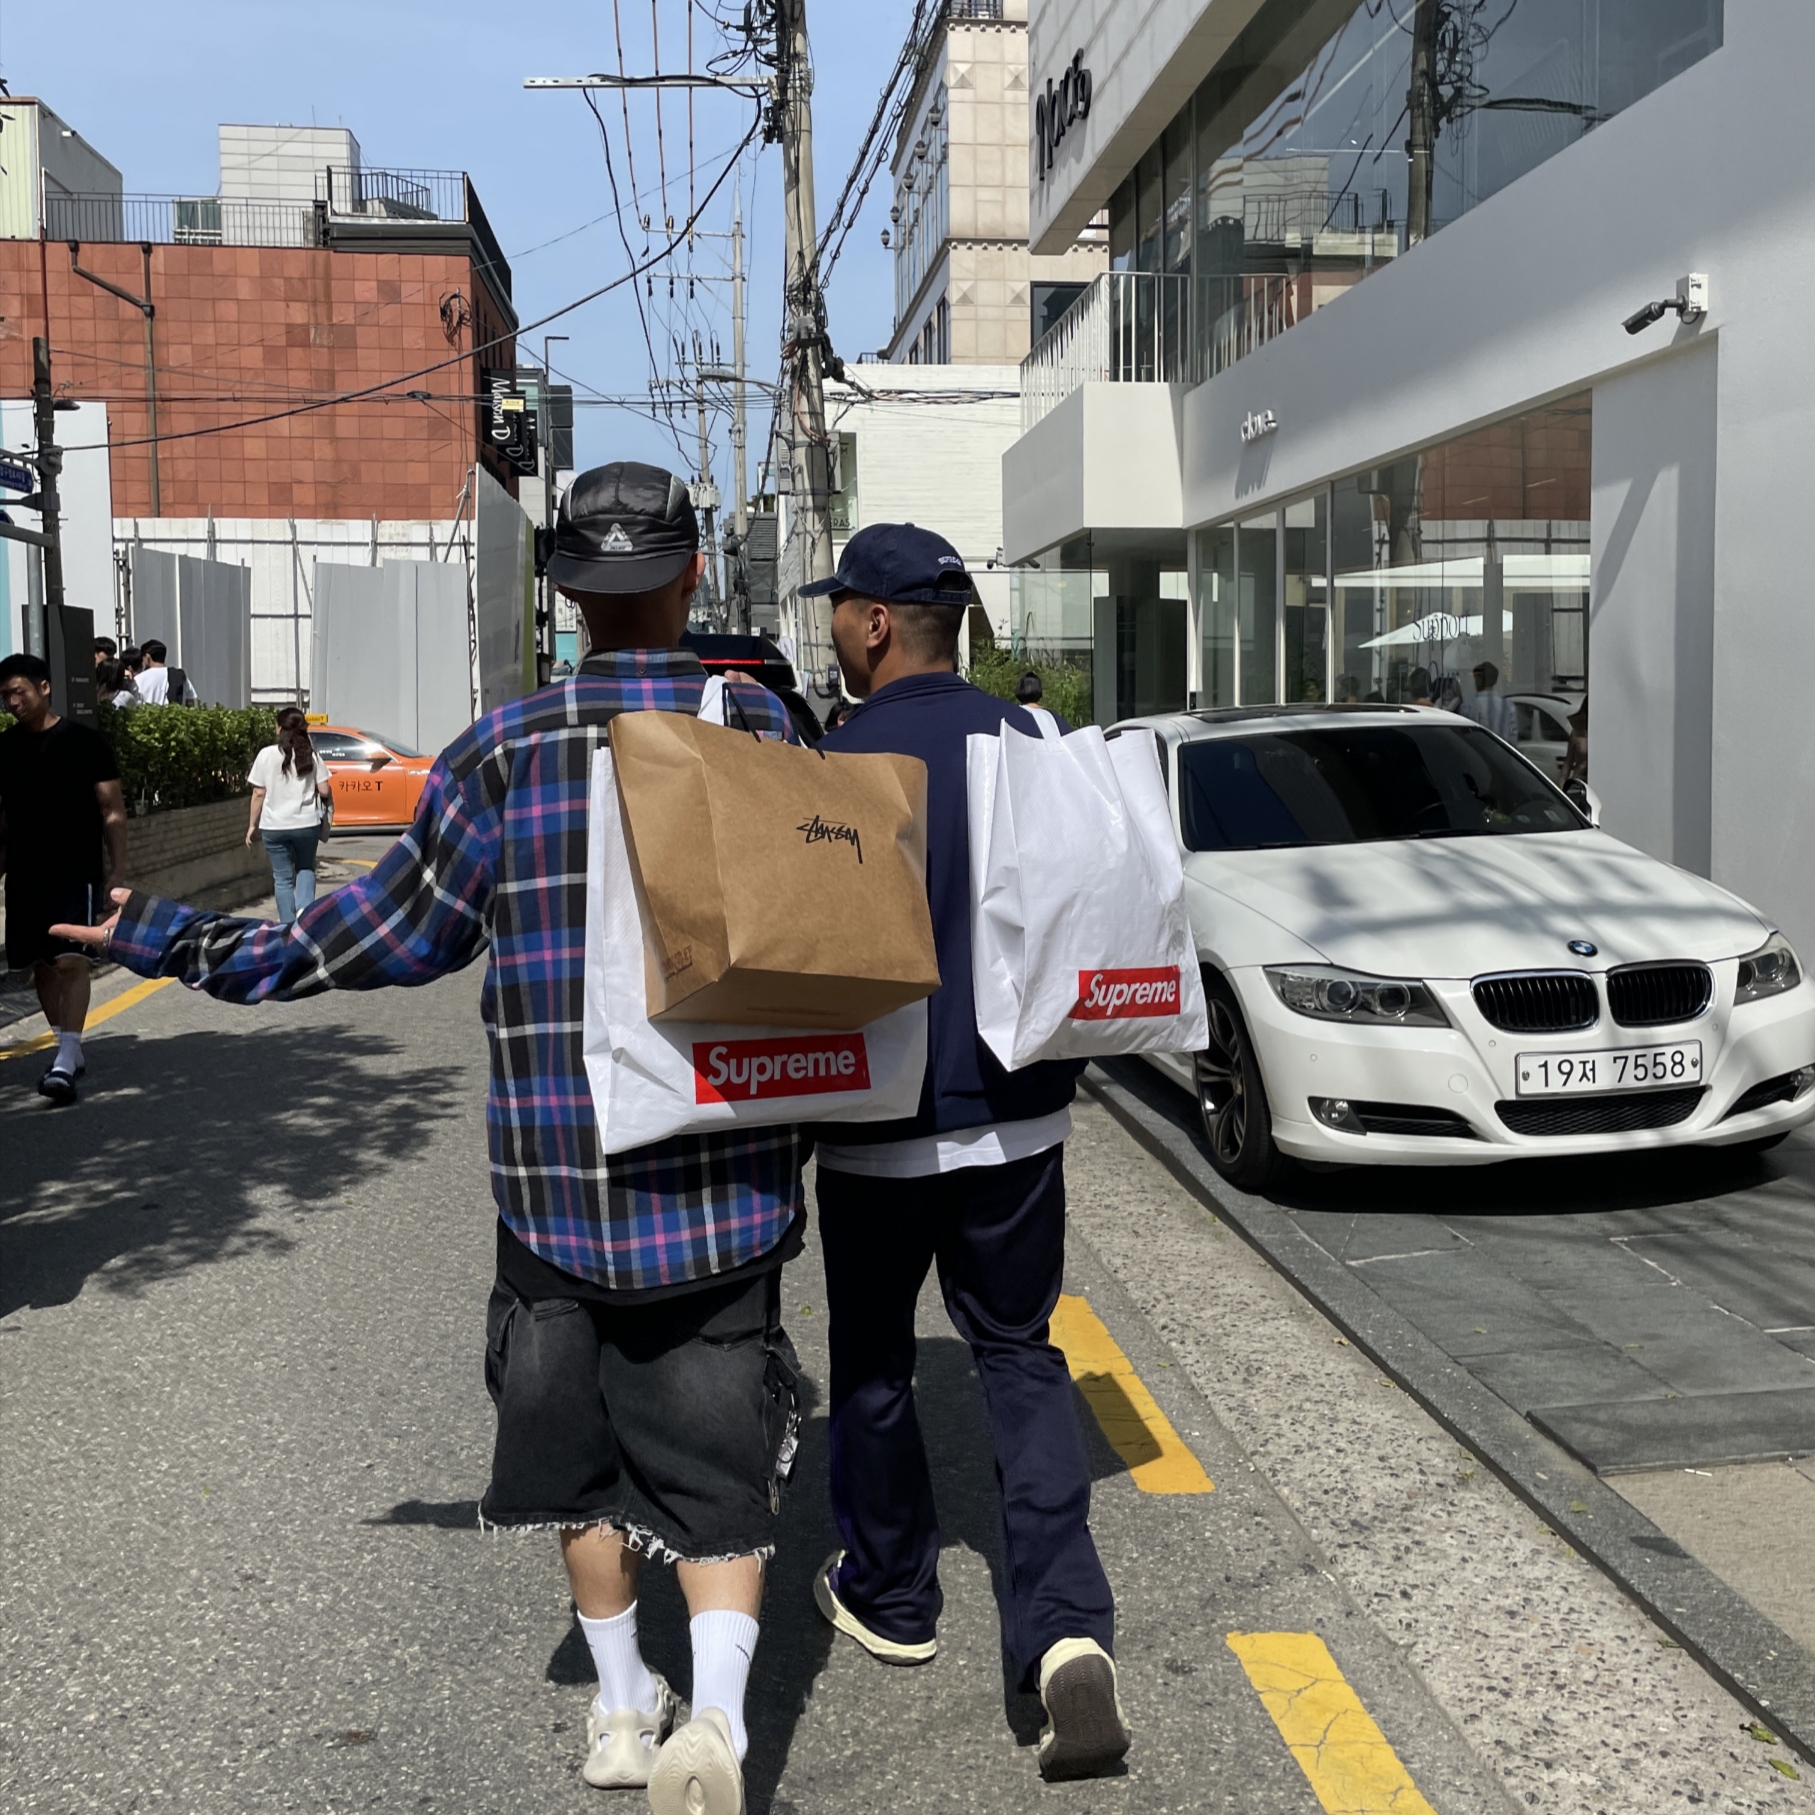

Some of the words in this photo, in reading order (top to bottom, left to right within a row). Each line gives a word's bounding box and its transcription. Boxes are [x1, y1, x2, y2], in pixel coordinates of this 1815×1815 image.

[1084, 973, 1177, 1016] Supreme
[707, 1045, 856, 1095] Supreme
[1537, 1059, 1596, 1088] 19저
[1612, 1050, 1686, 1084] 7558
